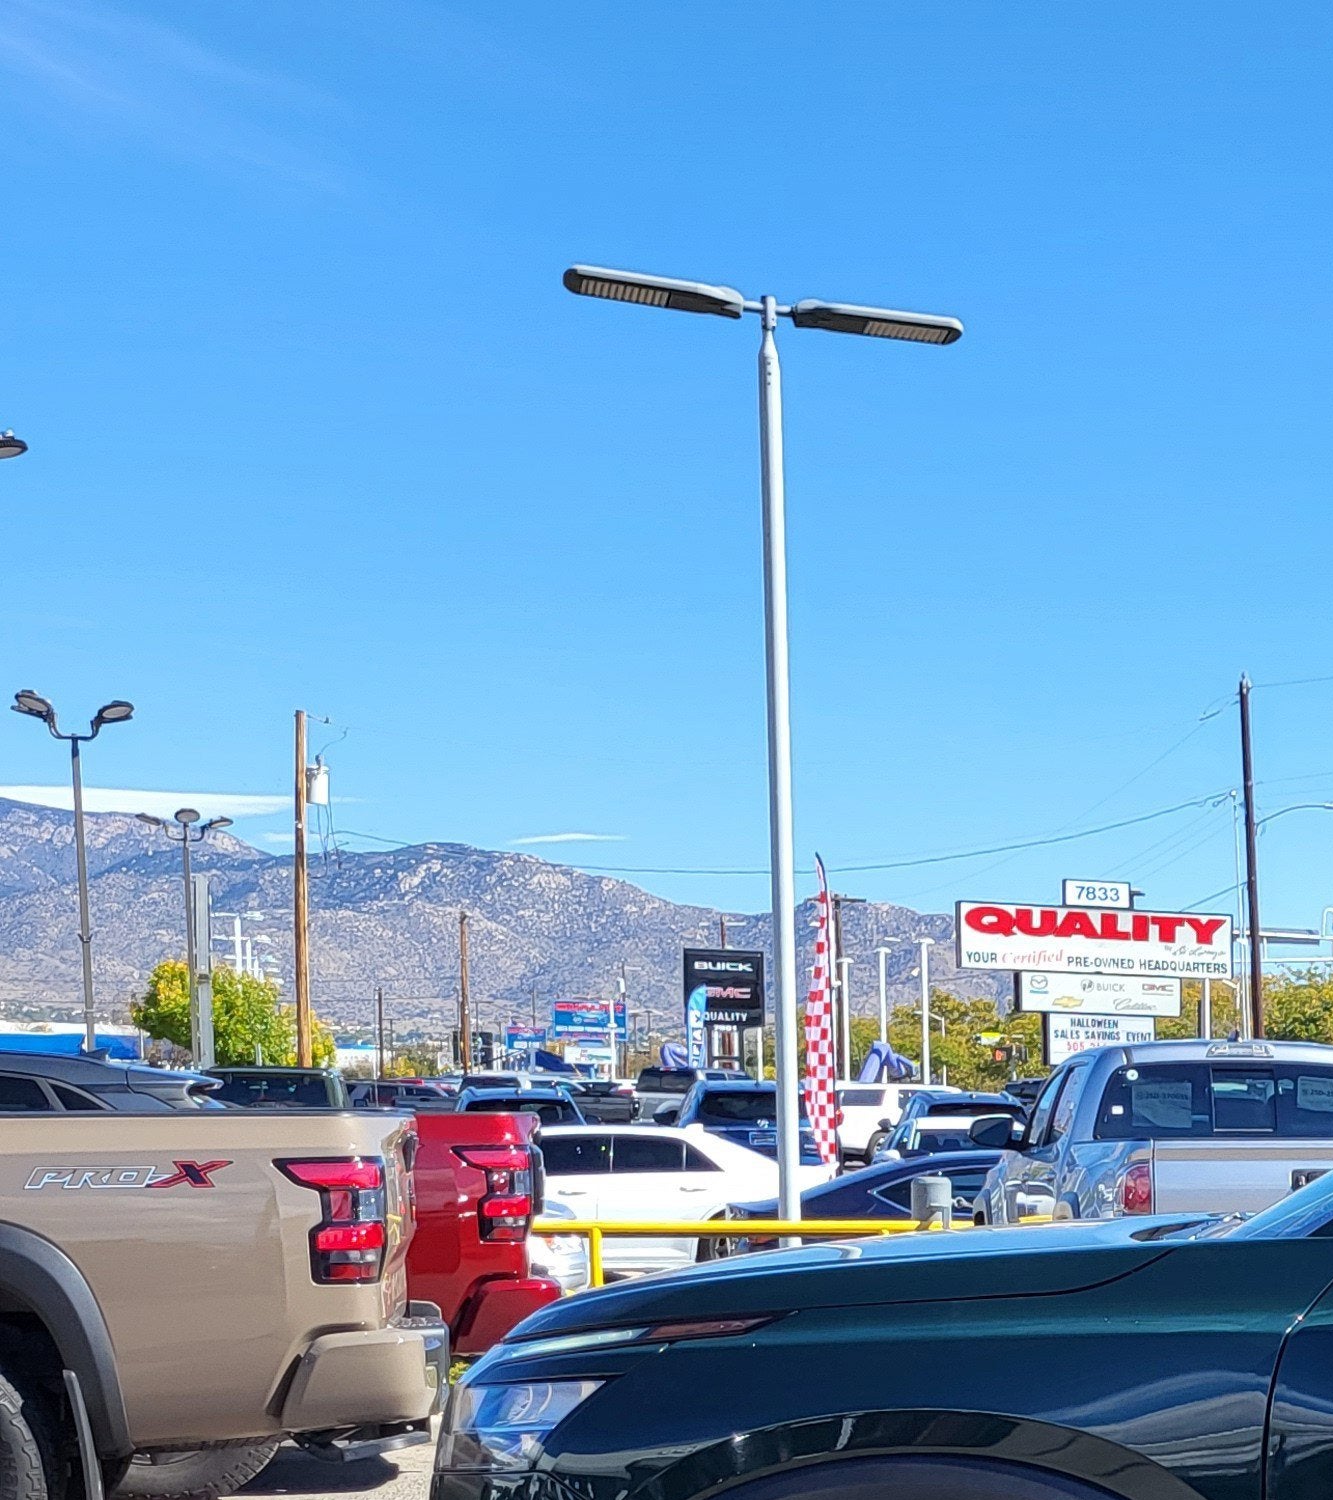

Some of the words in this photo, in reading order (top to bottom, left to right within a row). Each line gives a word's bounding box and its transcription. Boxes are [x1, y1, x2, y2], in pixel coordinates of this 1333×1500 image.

[1075, 885, 1120, 902] 7833
[965, 906, 1227, 945] QUALITY
[694, 961, 754, 972] BUICK
[966, 951, 998, 964] YOUR
[1002, 949, 1064, 966] Certified
[1066, 956, 1135, 970] PRE-OWNED
[1138, 959, 1228, 974] HEADQUARTERS
[1096, 983, 1126, 992] BUICK
[1141, 984, 1174, 992] GMC
[704, 1011, 748, 1021] QUALITY
[1070, 1018, 1119, 1028] HALLOWEEN
